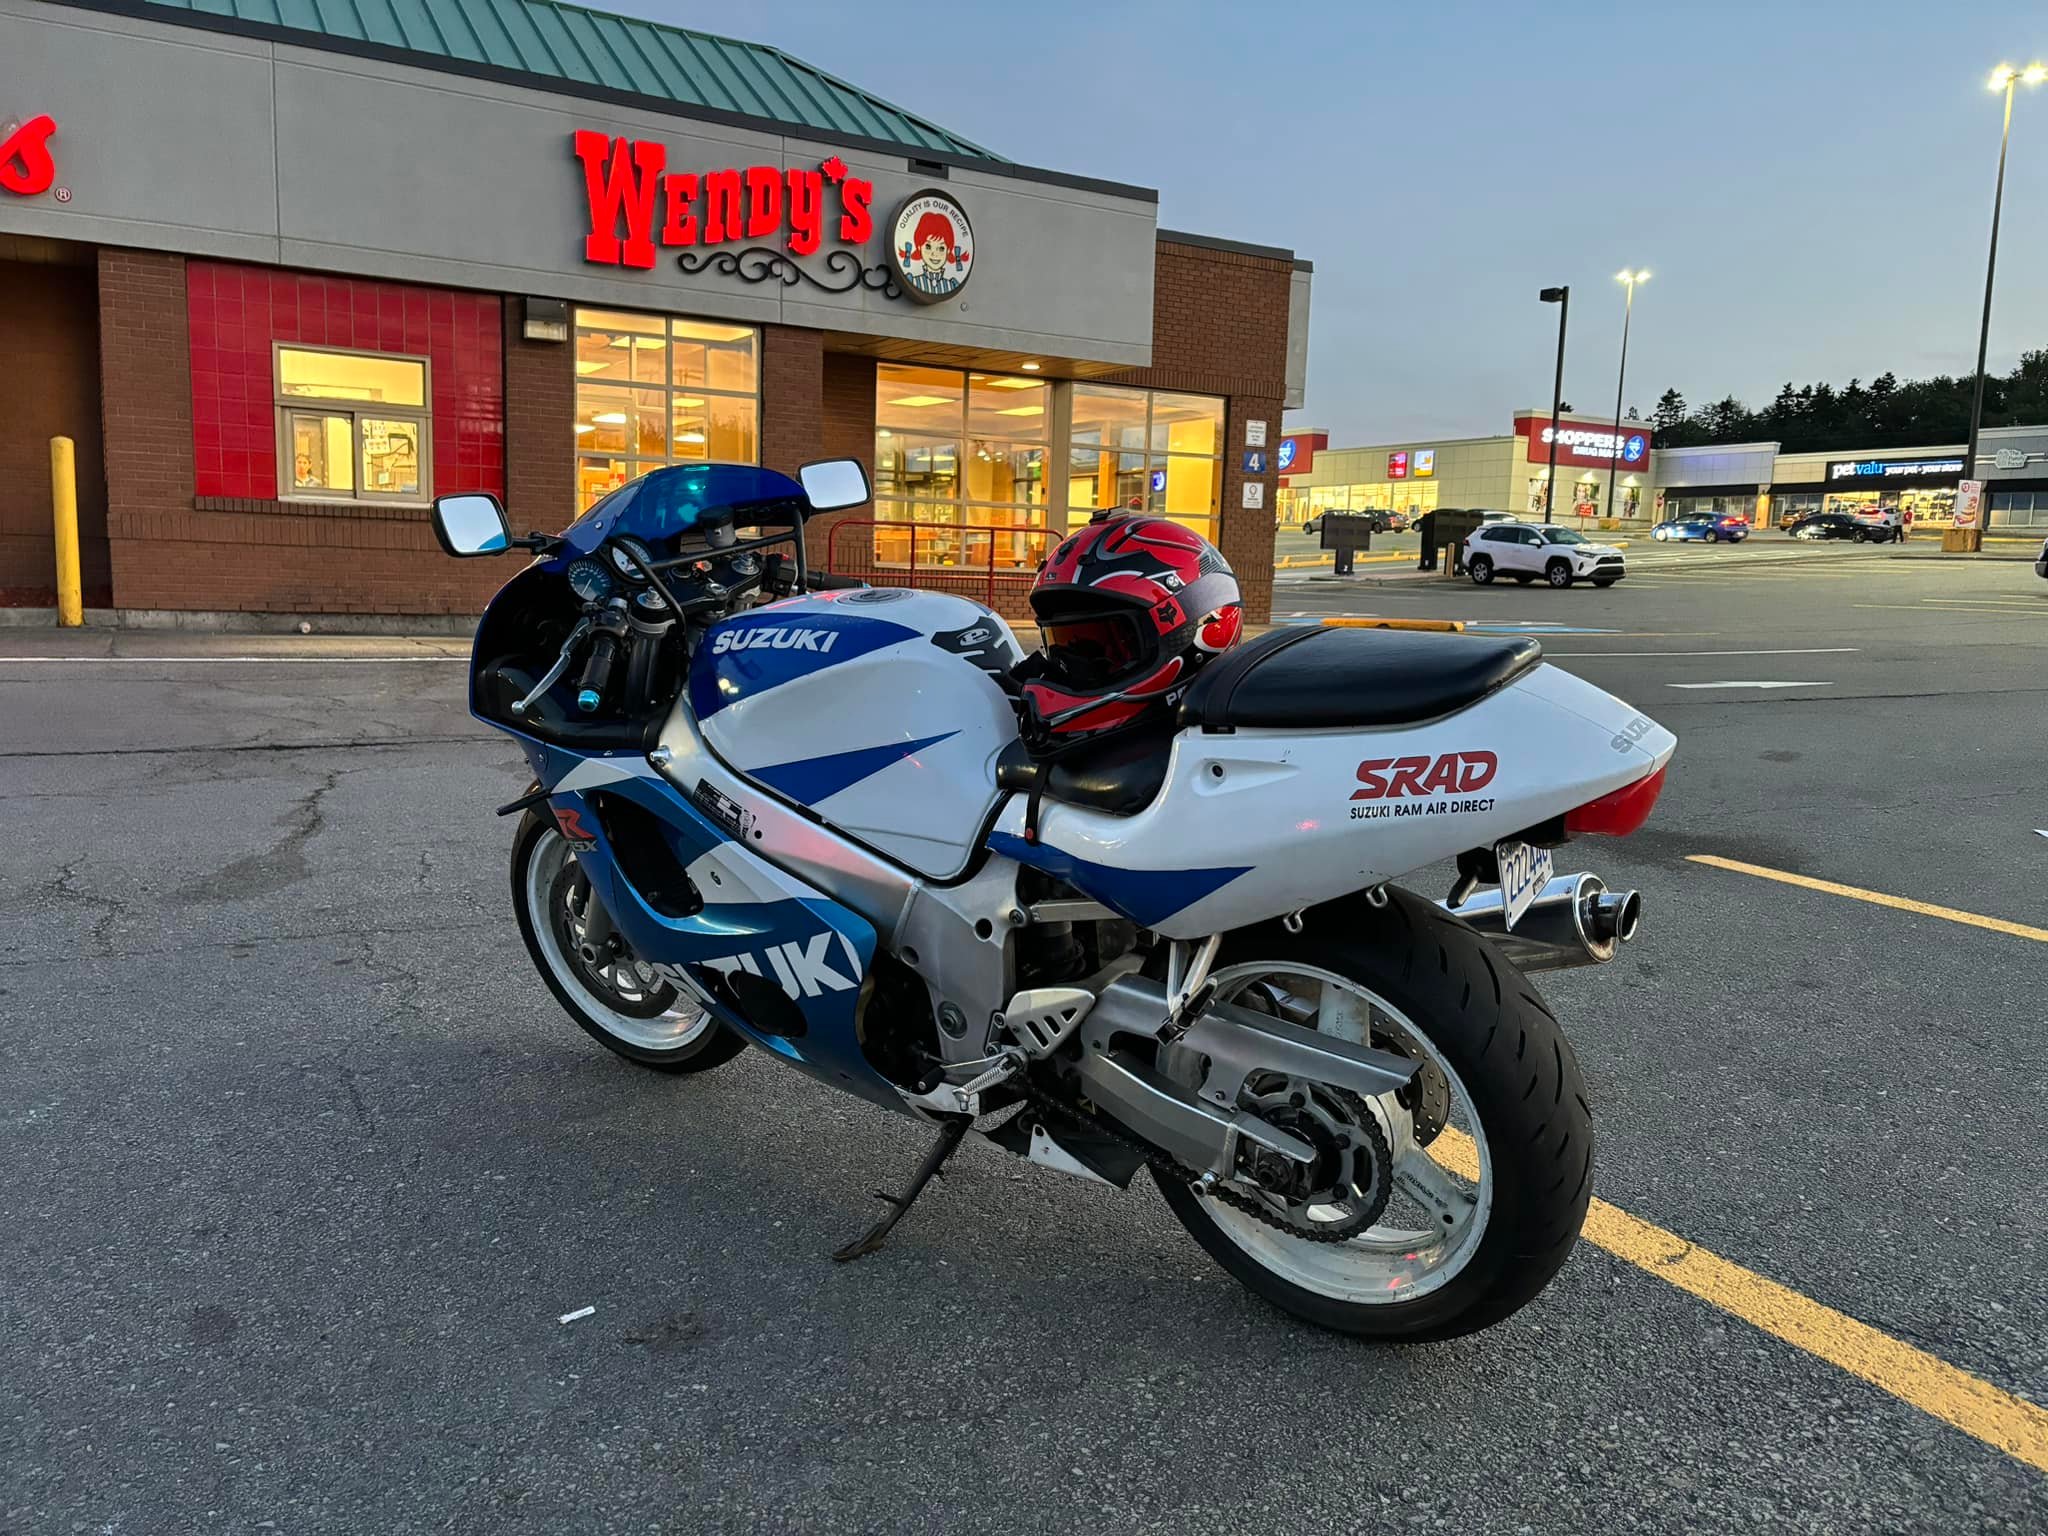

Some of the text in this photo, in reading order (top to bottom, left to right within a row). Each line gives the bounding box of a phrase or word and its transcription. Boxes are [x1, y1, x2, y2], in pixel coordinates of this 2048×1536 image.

[900, 202, 922, 229] QUALITY
[932, 200, 949, 211] OUR
[949, 209, 969, 238] RECIPE
[1248, 453, 1260, 471] 4
[712, 627, 840, 654] SUZUKI
[1349, 750, 1498, 801] SRAD
[1350, 799, 1496, 820] SUZUKI RAM AIR DIRECT
